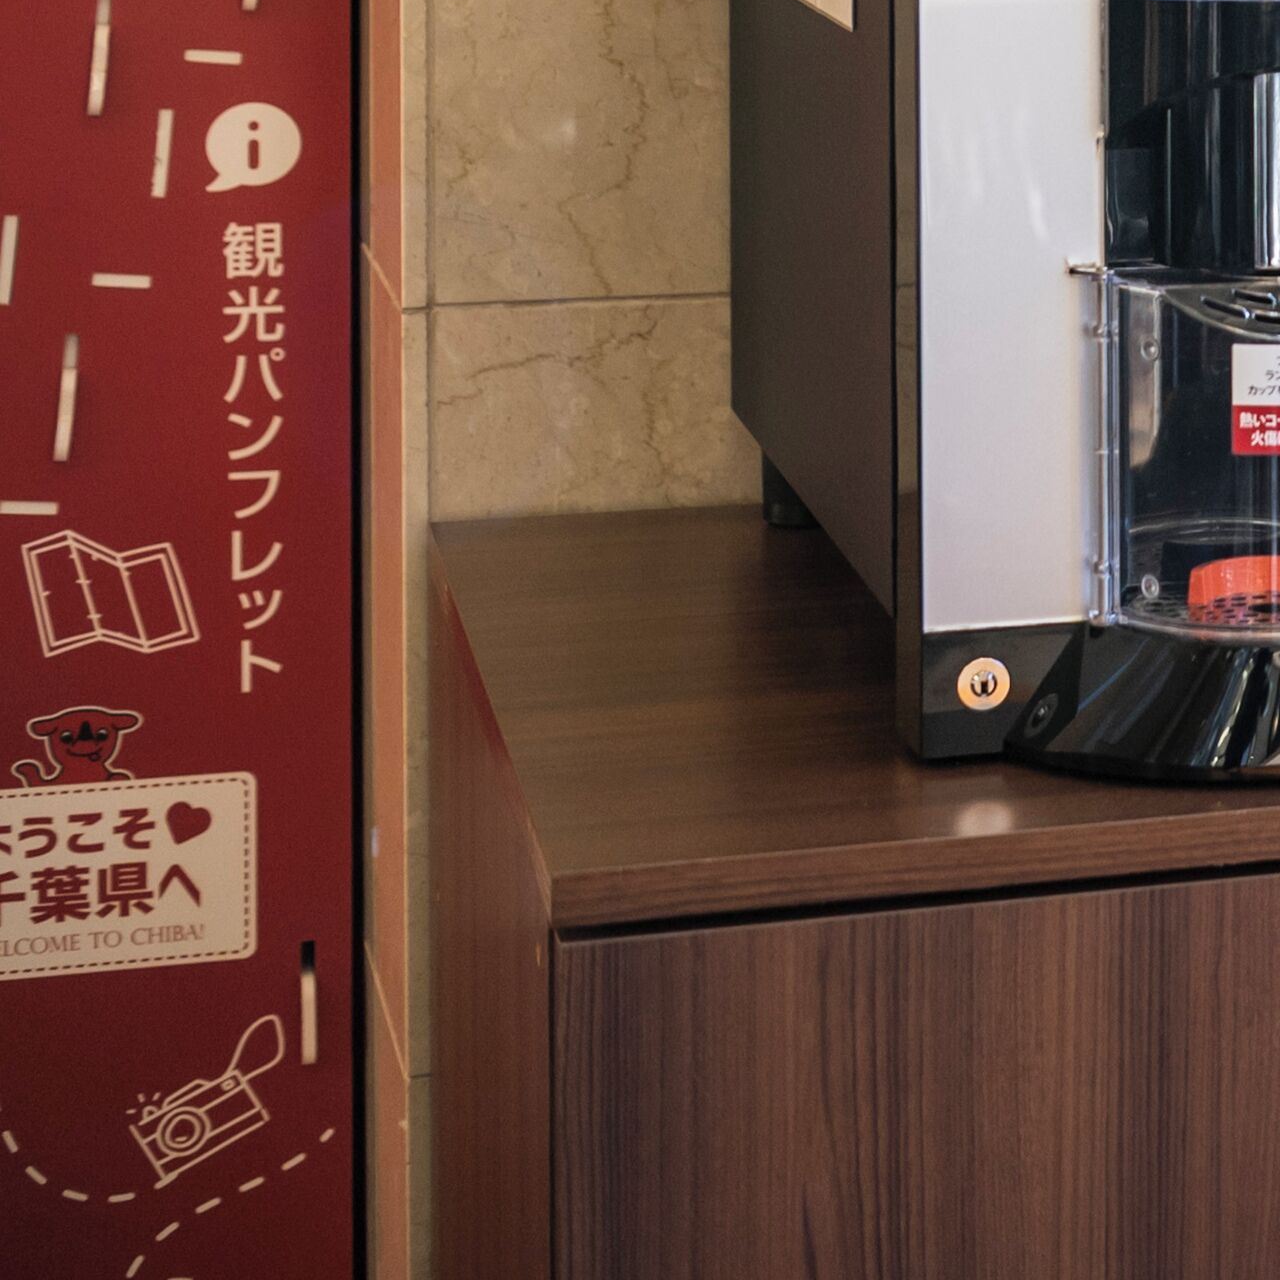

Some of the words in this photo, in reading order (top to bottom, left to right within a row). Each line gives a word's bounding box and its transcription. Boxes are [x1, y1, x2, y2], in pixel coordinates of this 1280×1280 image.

[222, 221, 286, 694] 観光パンフレット
[88, 930, 123, 949] TO
[130, 923, 205, 946] CHIBA!
